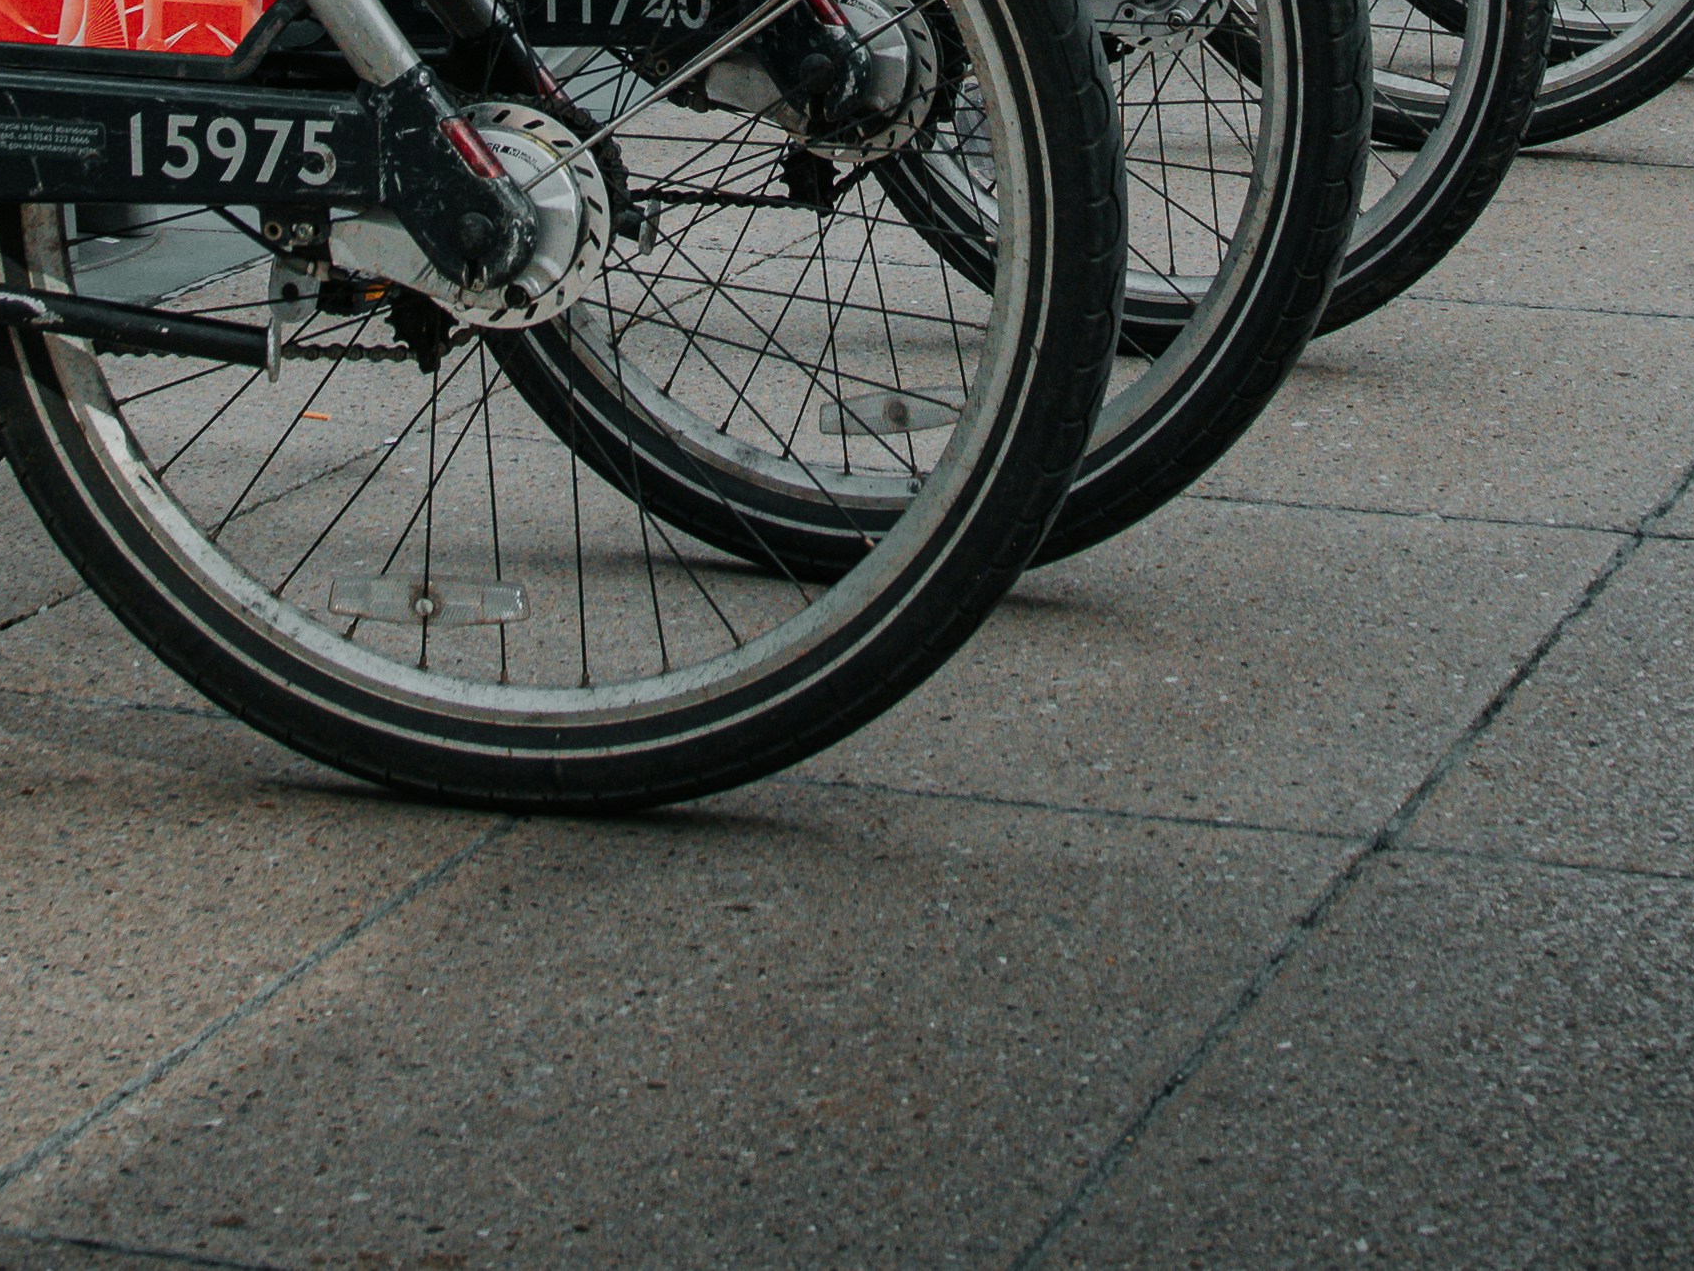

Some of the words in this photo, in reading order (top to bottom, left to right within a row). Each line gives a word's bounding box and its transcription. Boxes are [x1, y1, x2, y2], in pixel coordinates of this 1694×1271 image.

[29, 123, 54, 133] found
[55, 125, 99, 136] abandoned
[18, 133, 32, 141] call
[130, 111, 337, 186] 15975
